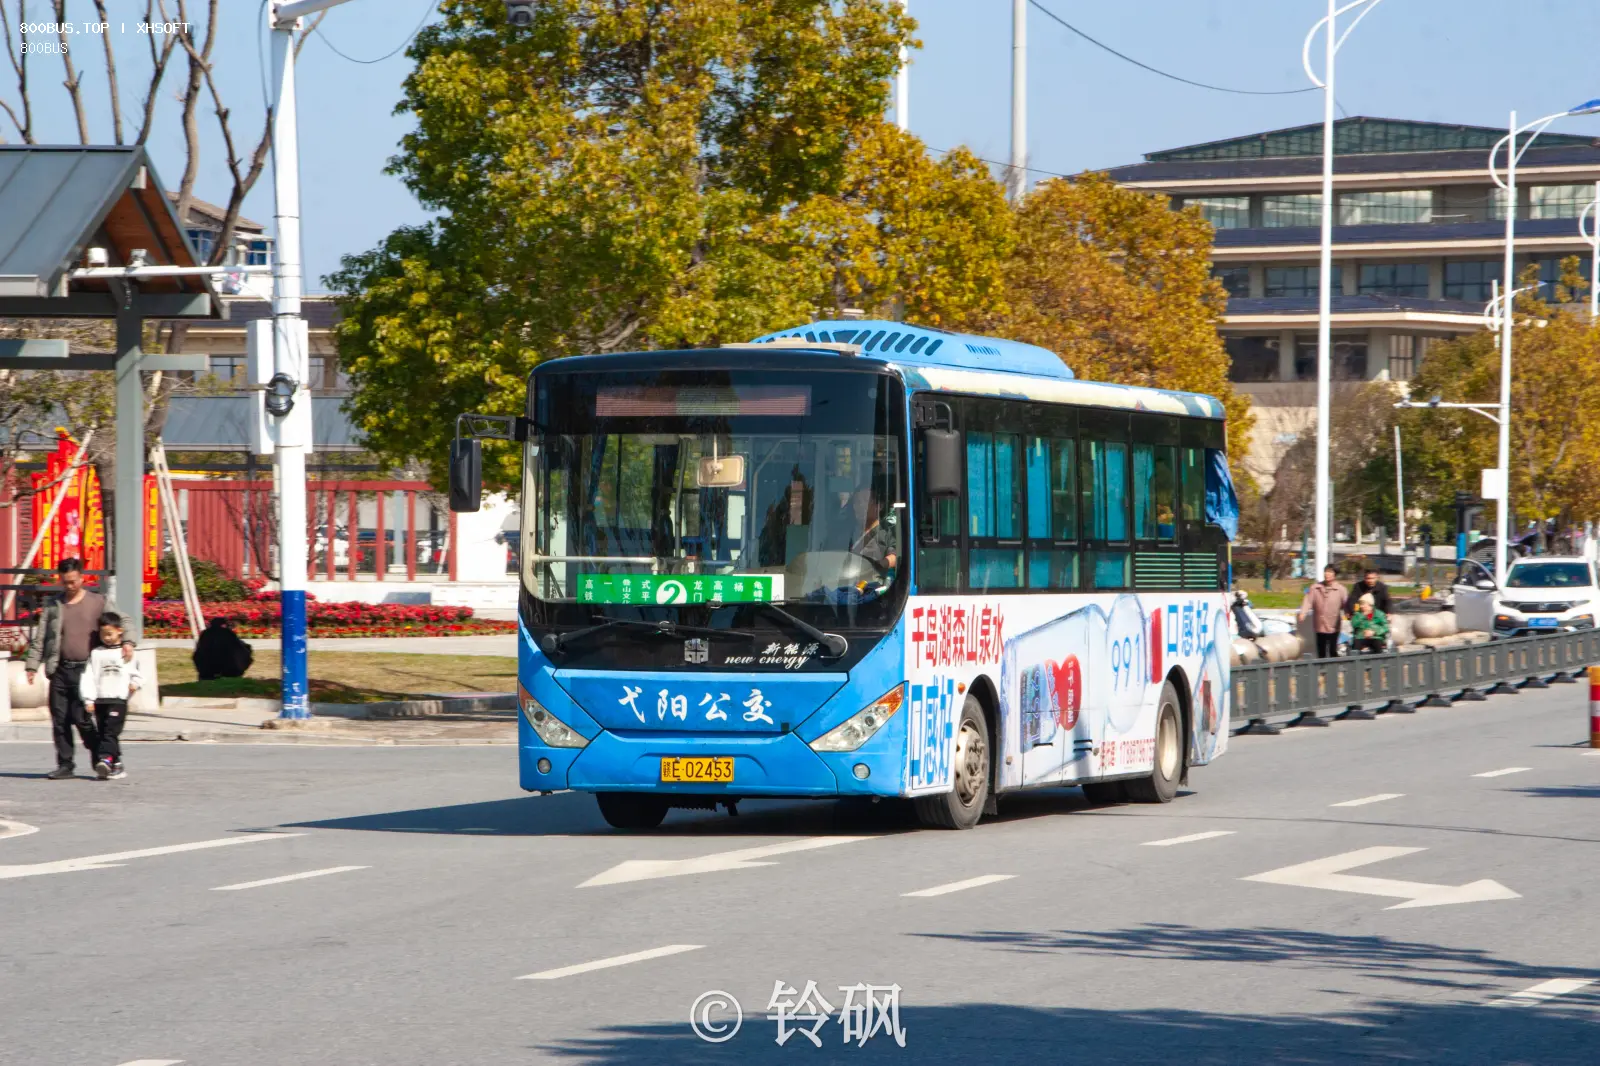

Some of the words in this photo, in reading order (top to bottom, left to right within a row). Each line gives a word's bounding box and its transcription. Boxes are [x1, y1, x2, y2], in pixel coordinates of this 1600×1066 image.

[584, 579, 594, 601] 高铁
[663, 583, 680, 604] 2
[693, 580, 704, 603] 龙门
[911, 603, 1005, 669] 千岛湖森山泉水
[1167, 600, 1208, 657] 口感好
[724, 655, 757, 665] new
[759, 655, 810, 669] energy
[762, 642, 820, 656] 新能源
[1111, 633, 1140, 694] 991
[618, 685, 774, 725] 弋阳公交
[910, 675, 955, 786] 口感好
